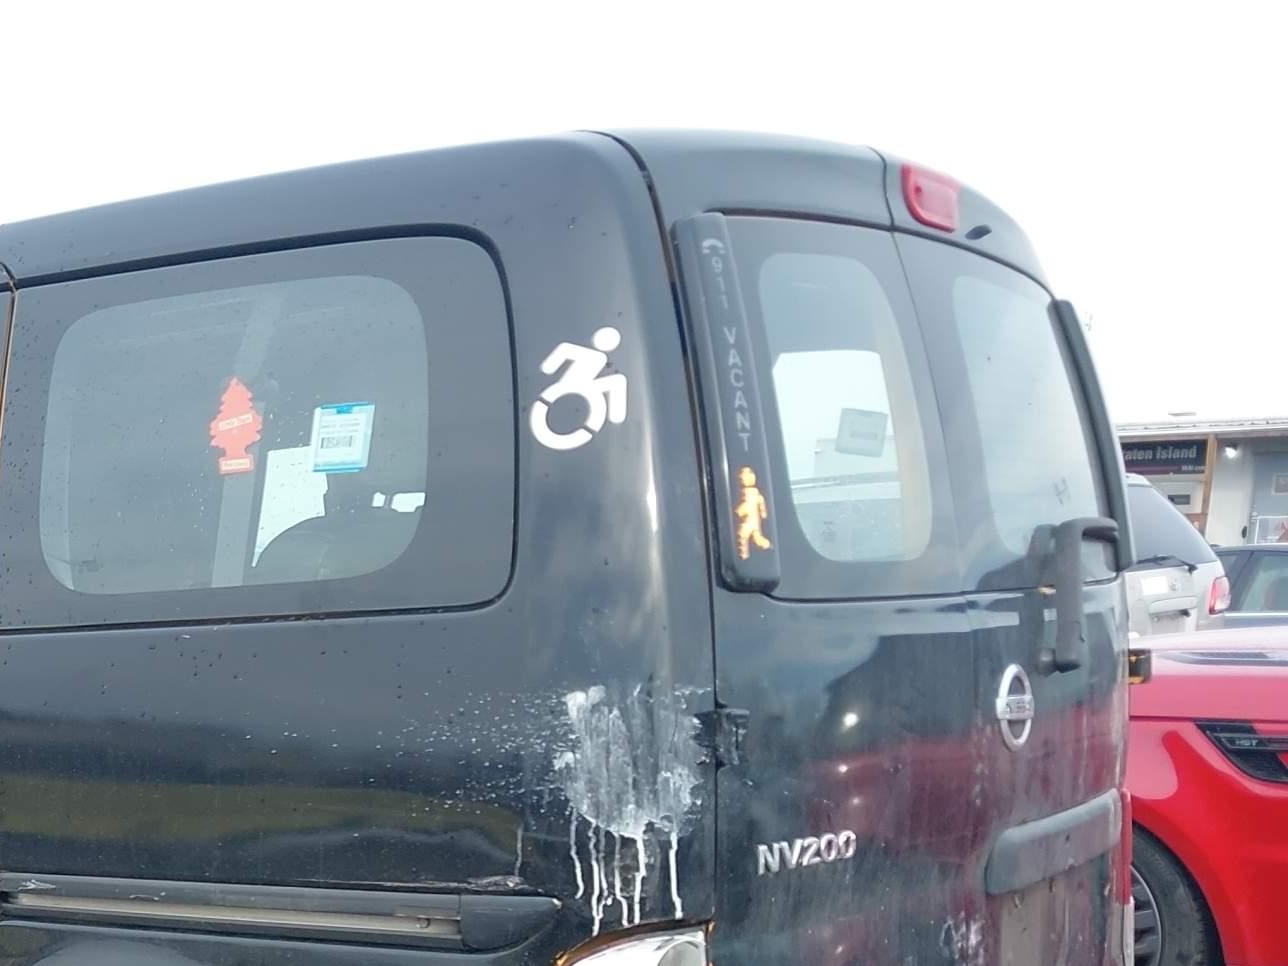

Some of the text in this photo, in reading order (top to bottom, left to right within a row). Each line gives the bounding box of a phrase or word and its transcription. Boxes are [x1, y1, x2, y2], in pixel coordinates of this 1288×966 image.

[723, 326, 751, 452] VACANT
[1123, 445, 1198, 460] aten Island
[757, 829, 857, 876] NV200
